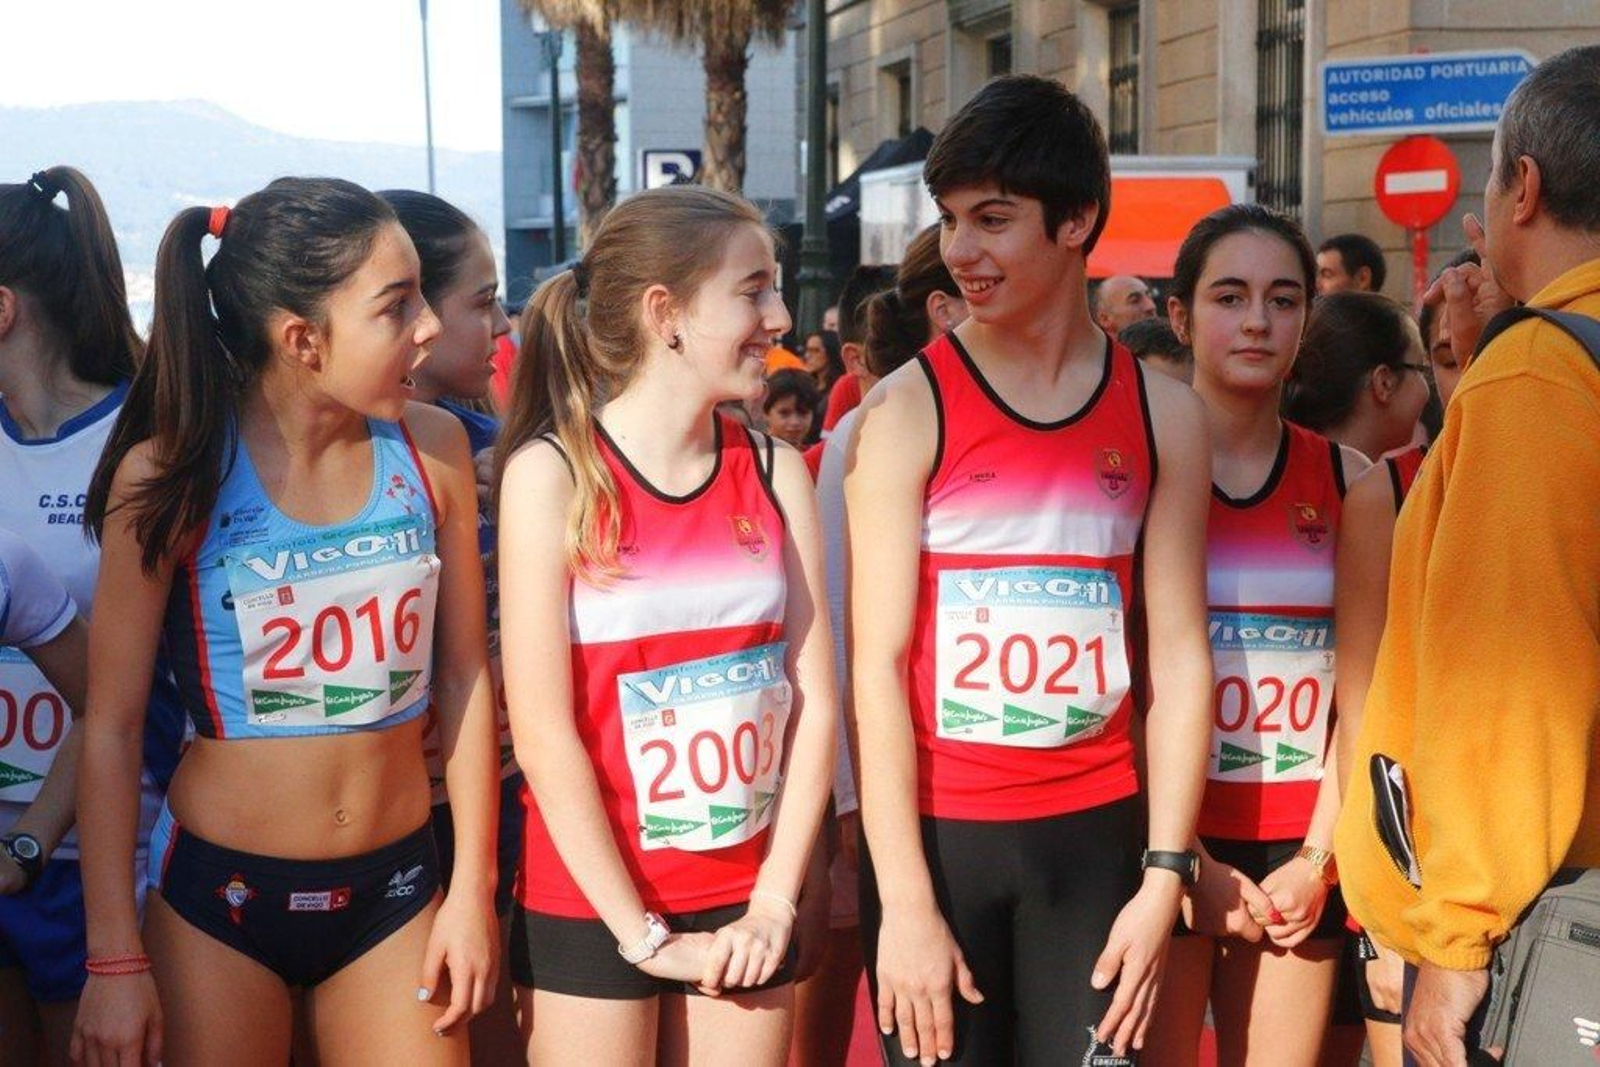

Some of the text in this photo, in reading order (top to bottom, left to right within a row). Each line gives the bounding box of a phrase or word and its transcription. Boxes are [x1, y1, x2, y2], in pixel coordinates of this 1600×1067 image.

[1328, 60, 1528, 85] AUTORIDAD PORTUARIA
[1328, 90, 1390, 105] acceso
[1425, 101, 1502, 120] oficiales
[261, 587, 421, 680] 2016
[953, 632, 1107, 696] 2021
[639, 711, 775, 804] 2003
